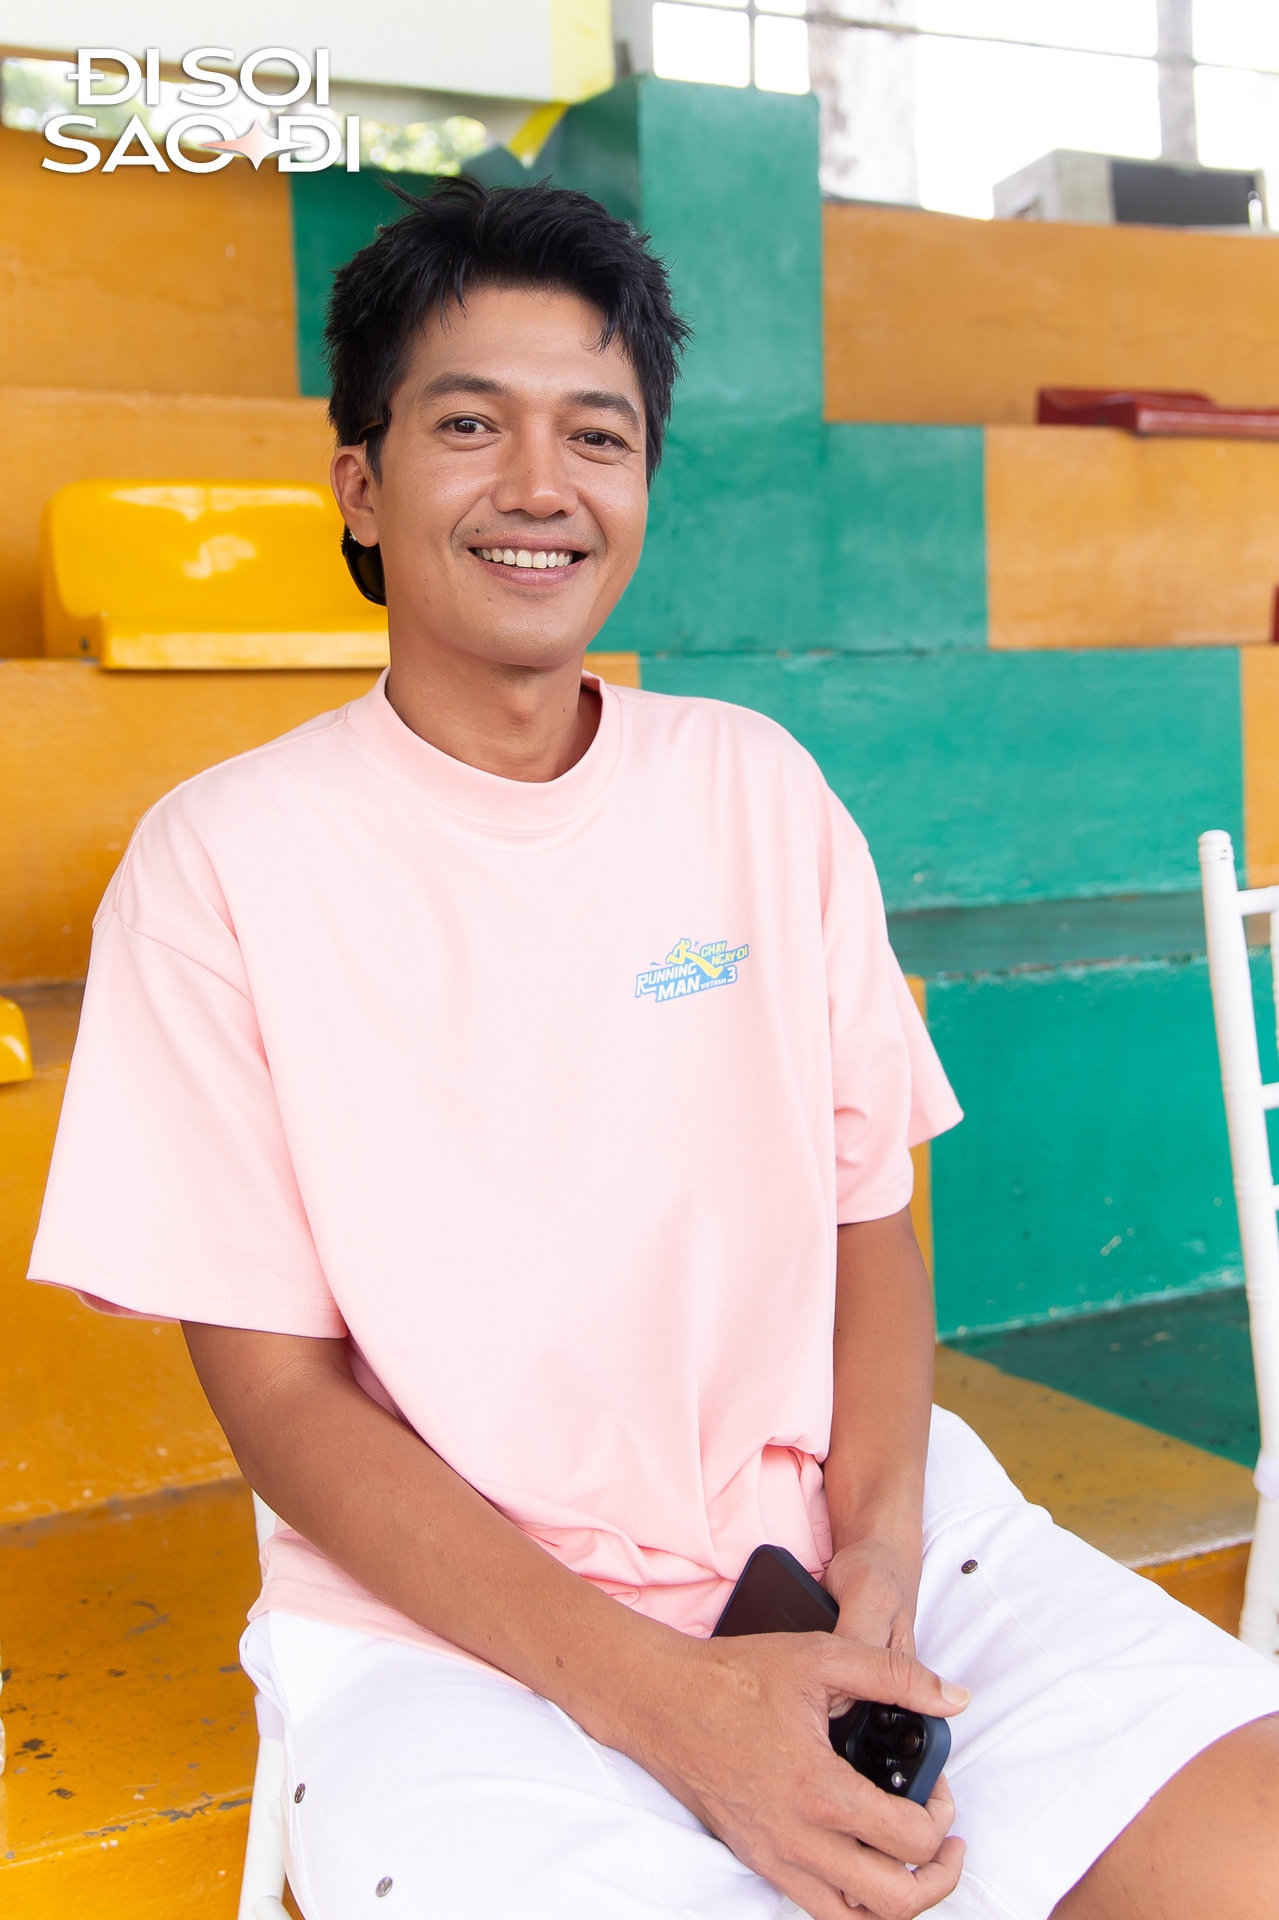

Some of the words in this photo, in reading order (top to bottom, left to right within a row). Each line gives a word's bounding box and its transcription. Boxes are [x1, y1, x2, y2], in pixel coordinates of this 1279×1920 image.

[712, 950, 736, 965] NGAY
[736, 945, 748, 960] ĐI
[636, 962, 698, 997] RUNNING
[657, 975, 701, 1001] MAN
[700, 978, 727, 989] VIETNAM
[726, 966, 737, 982] 3
